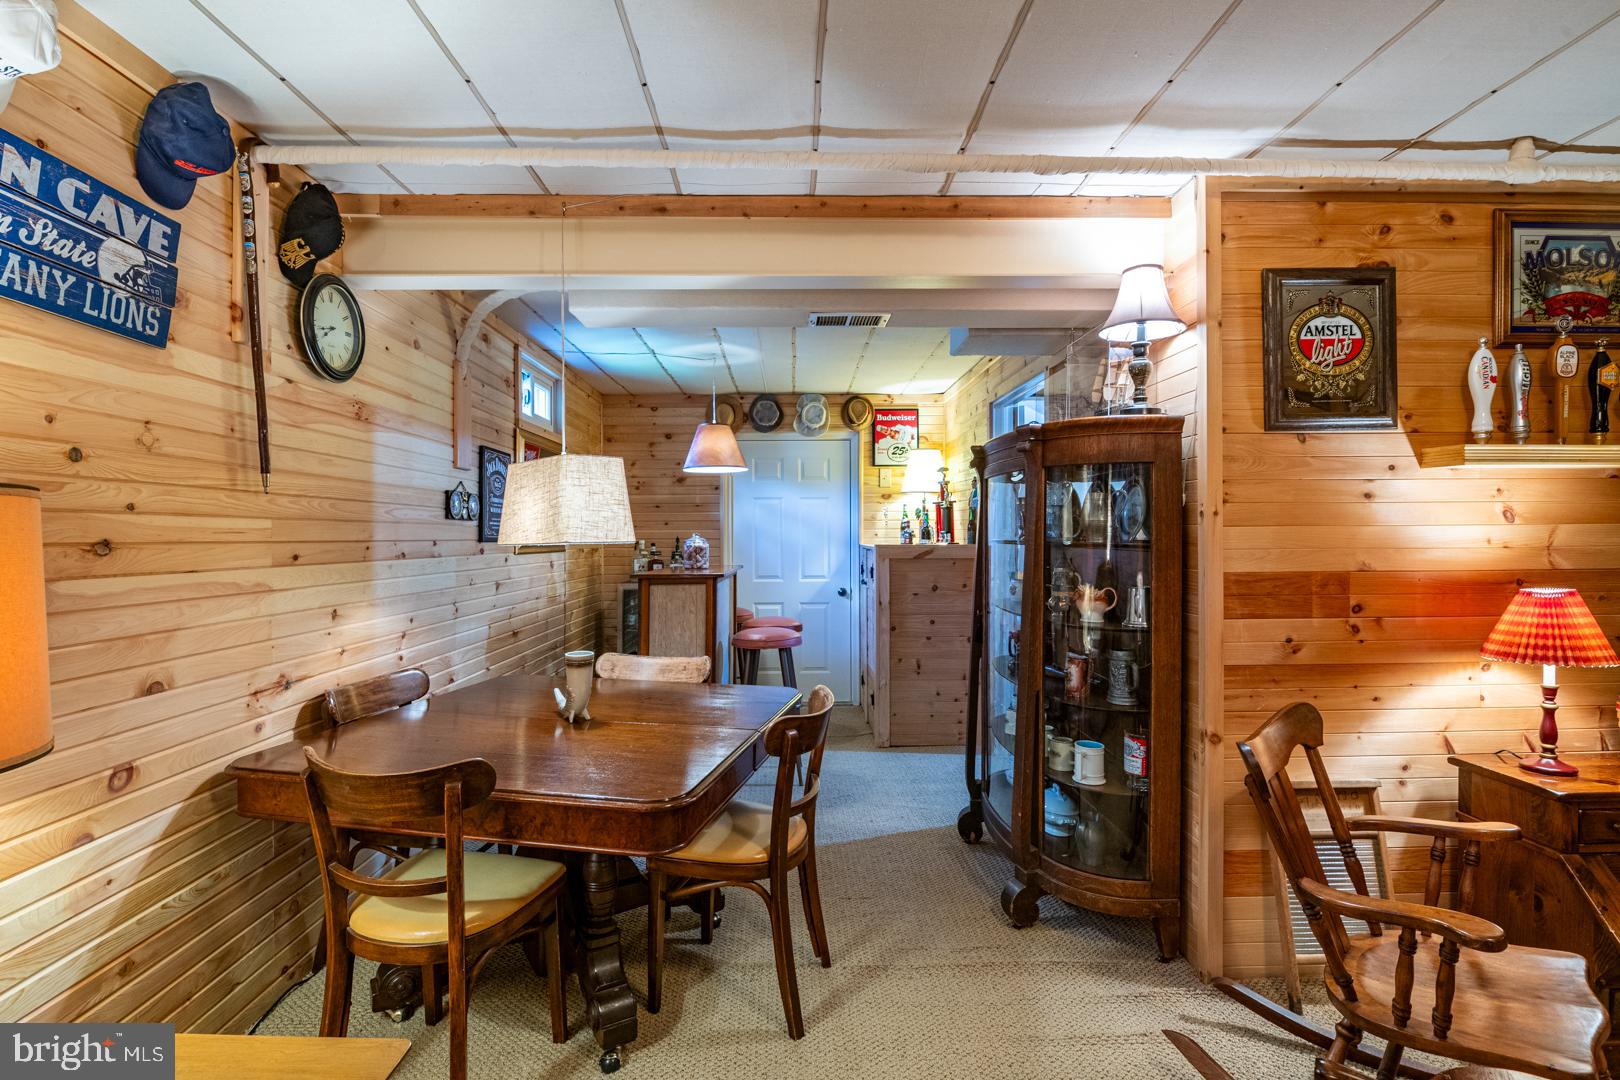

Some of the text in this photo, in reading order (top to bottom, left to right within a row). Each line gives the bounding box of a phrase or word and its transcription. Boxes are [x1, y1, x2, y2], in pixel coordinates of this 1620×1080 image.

[56, 177, 172, 258] CAVE
[18, 217, 97, 268] State
[0, 251, 161, 337] ANY LIONS
[1303, 325, 1357, 337] AMSTEL
[1310, 335, 1353, 372] light
[1481, 356, 1490, 390] CANADIAN
[1519, 358, 1531, 390] LIGHT
